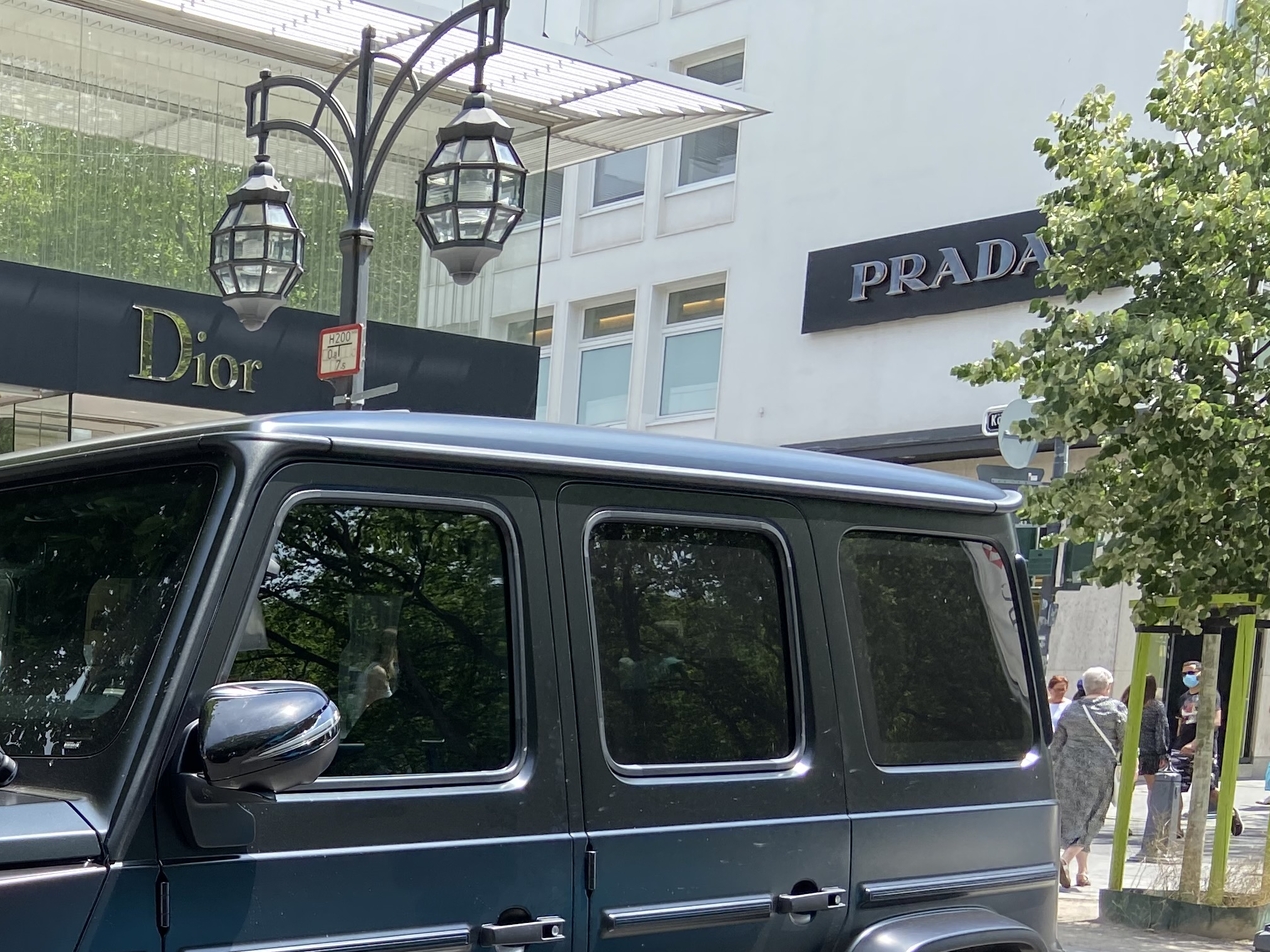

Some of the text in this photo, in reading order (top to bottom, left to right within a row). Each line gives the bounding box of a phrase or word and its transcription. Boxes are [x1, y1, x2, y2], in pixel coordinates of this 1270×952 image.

[848, 232, 1053, 302] PRADA
[128, 303, 263, 394] Dior
[328, 331, 351, 345] H200
